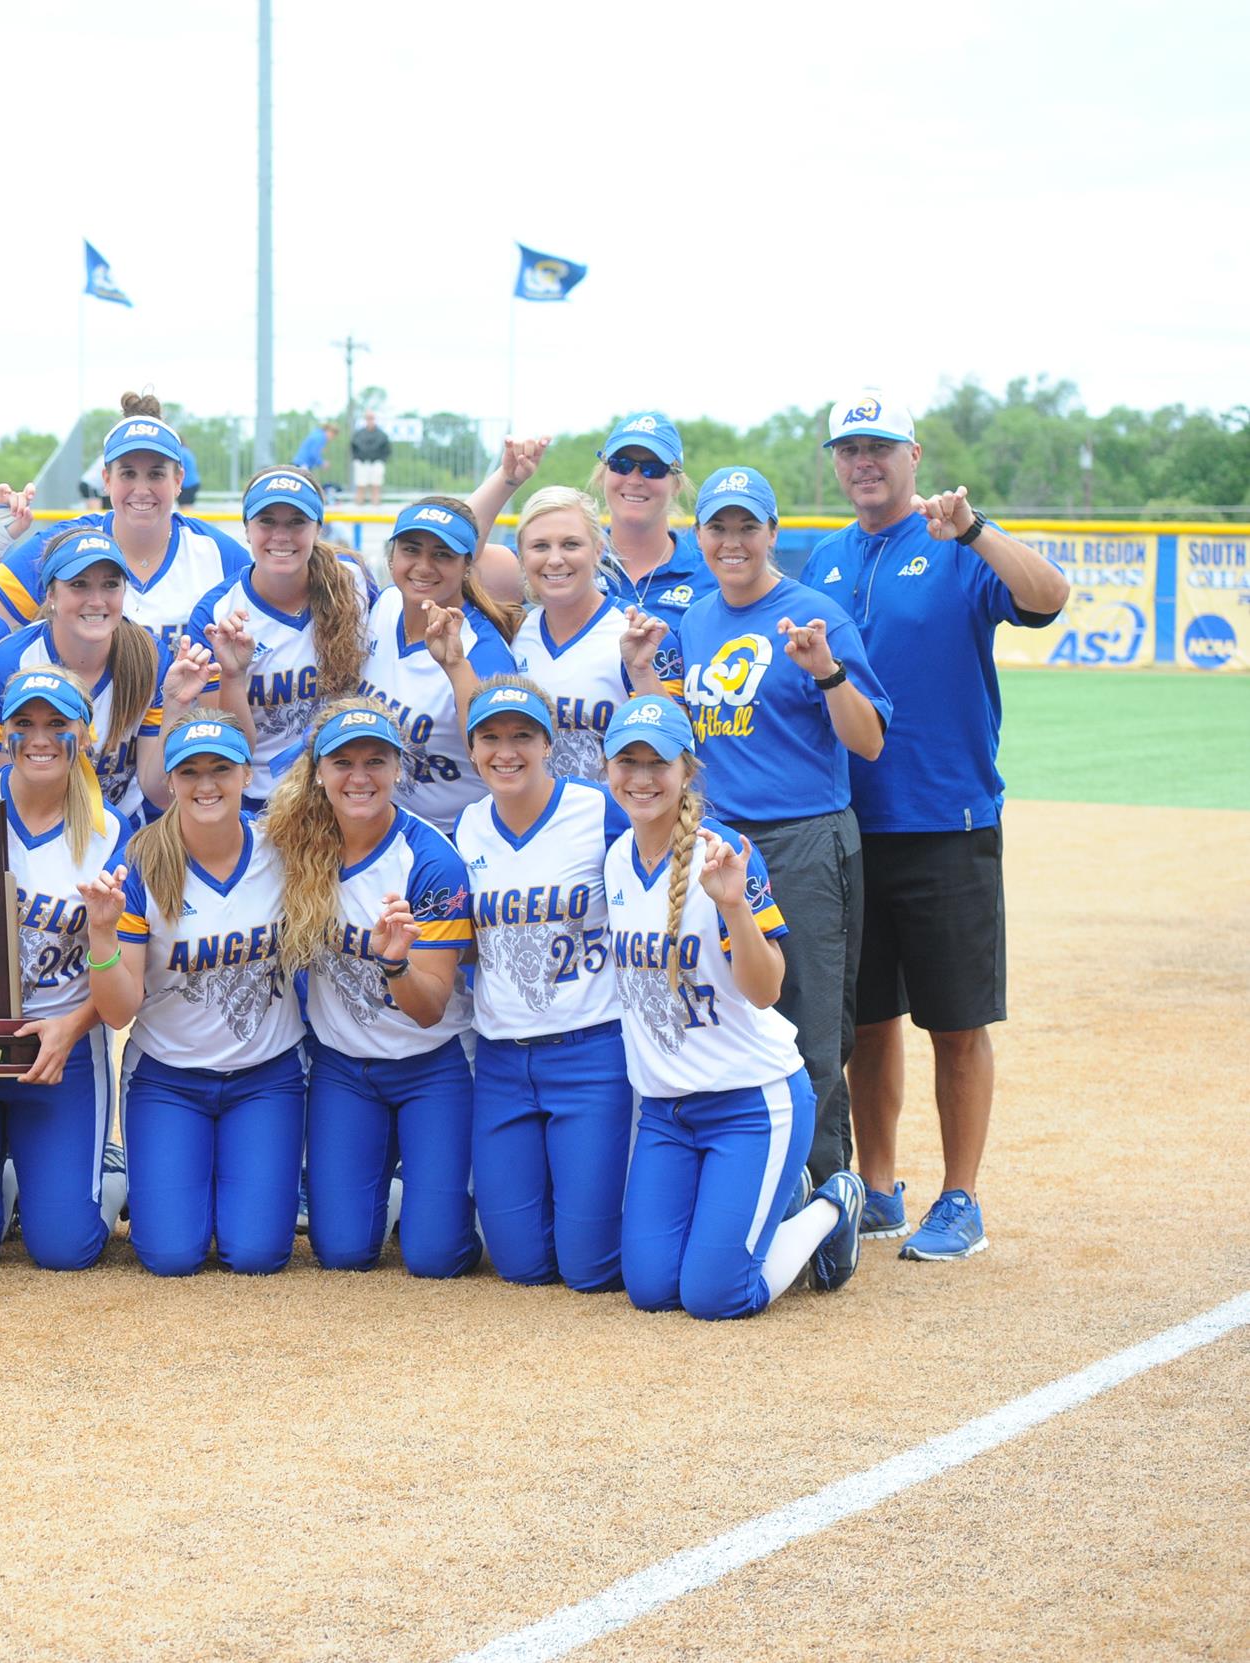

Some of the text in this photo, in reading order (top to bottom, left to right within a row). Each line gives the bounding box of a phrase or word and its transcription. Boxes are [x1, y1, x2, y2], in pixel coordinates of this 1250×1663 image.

[842, 397, 881, 425] ASU
[124, 424, 159, 437] ASU
[265, 478, 302, 492] ASU
[717, 472, 748, 490] ASU
[414, 508, 452, 525] ASU
[76, 538, 110, 552] ASU
[1189, 543, 1246, 566] SOUTH
[897, 556, 927, 576] ASU
[658, 585, 694, 603] ASU
[1048, 602, 1146, 664] ASU
[684, 634, 773, 706] ASU
[21, 676, 60, 690] ASU
[489, 690, 528, 703] ASU
[340, 713, 376, 728] ASU
[627, 704, 662, 720] ASU
[184, 724, 221, 741] ASU
[691, 706, 753, 743] oftball
[551, 927, 608, 984] 25
[611, 931, 701, 970] NGELO
